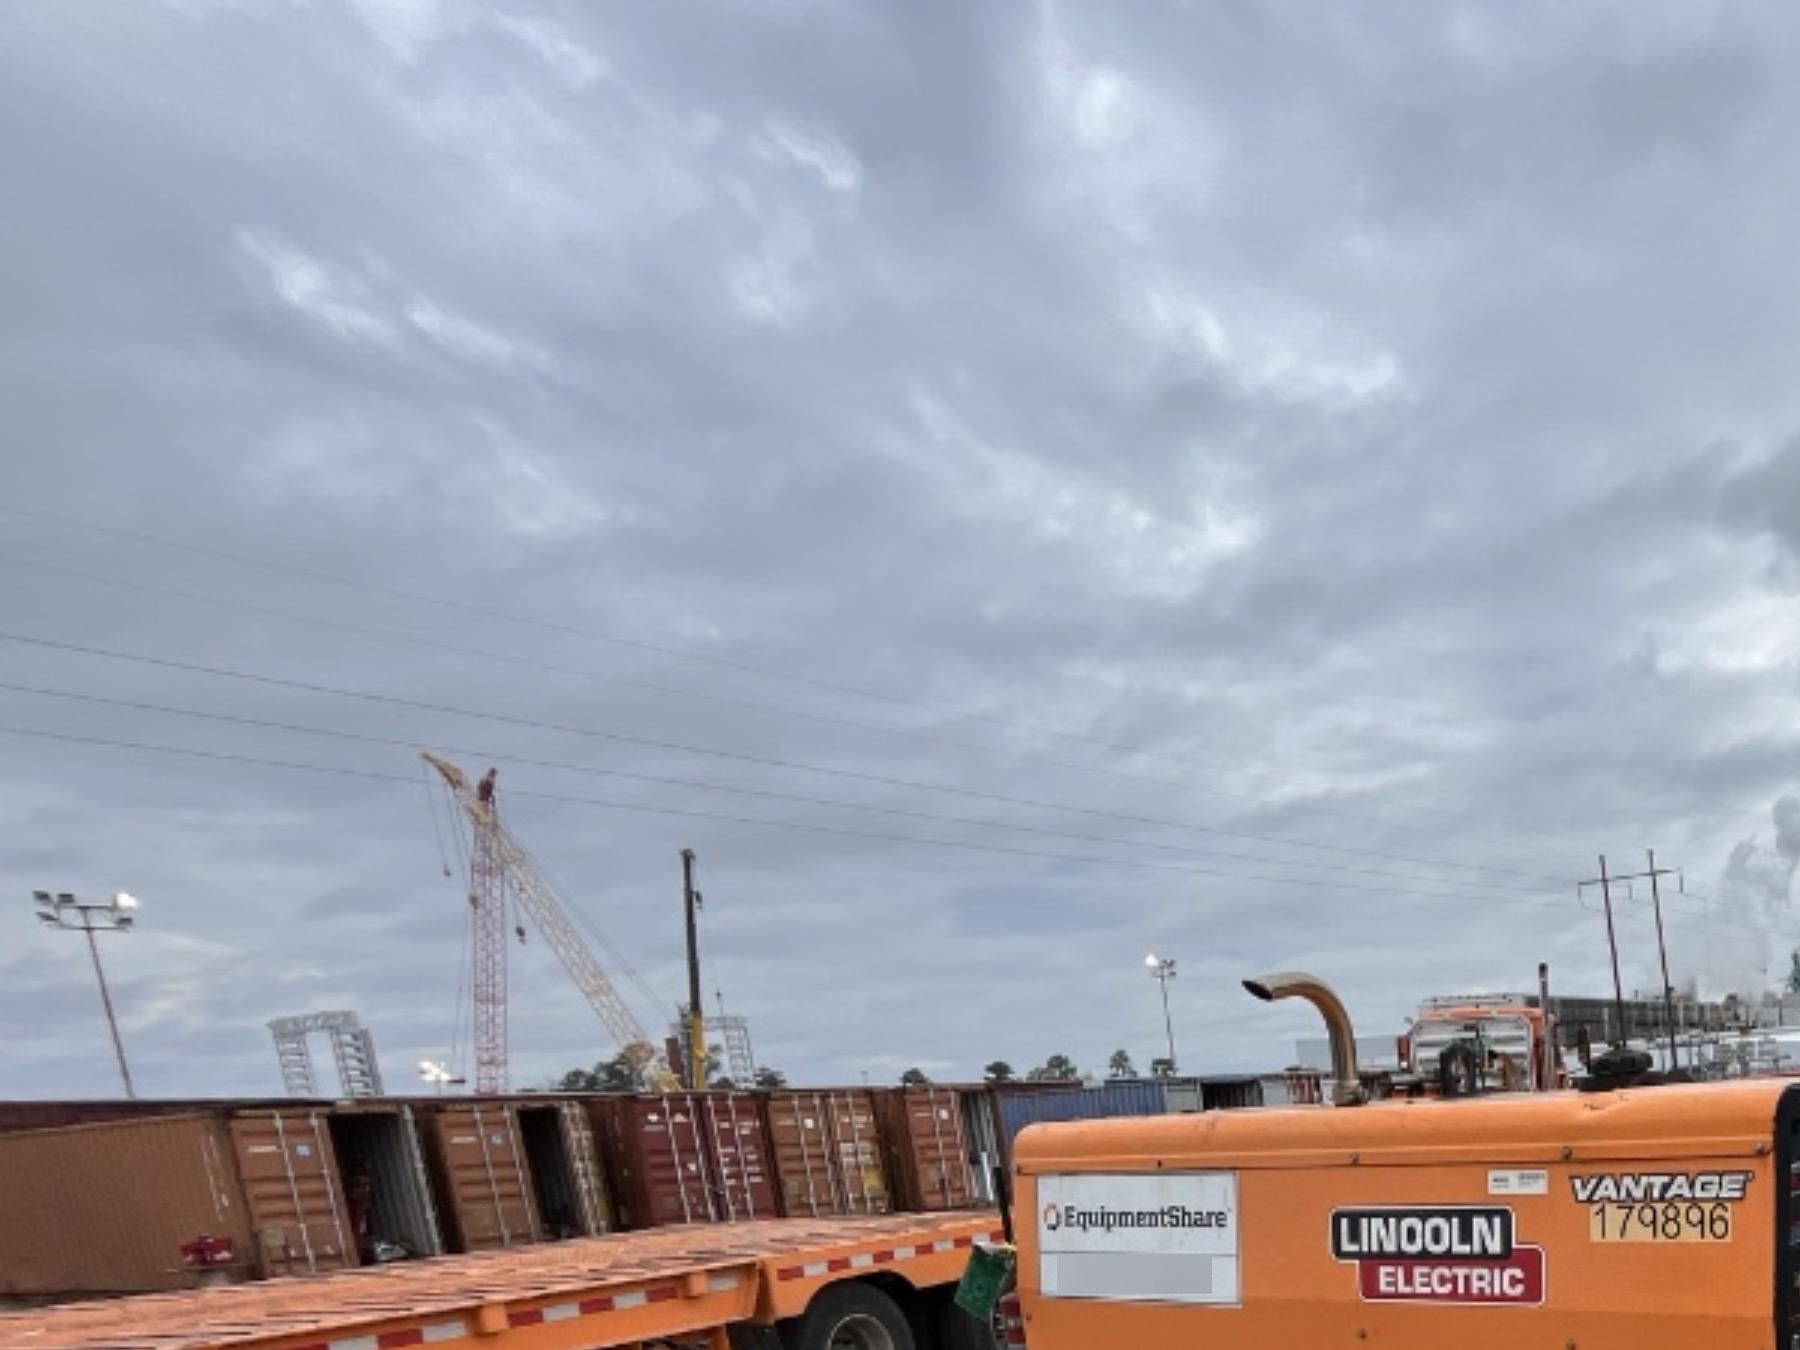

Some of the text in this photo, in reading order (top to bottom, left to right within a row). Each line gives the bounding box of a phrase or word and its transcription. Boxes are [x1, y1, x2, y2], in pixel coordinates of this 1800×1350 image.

[1570, 1172, 1748, 1201] VANTAGE
[1063, 1206, 1228, 1231] EquipmentShare
[1594, 1204, 1729, 1239] 179896
[1378, 1265, 1526, 1297] ELECTRIC
